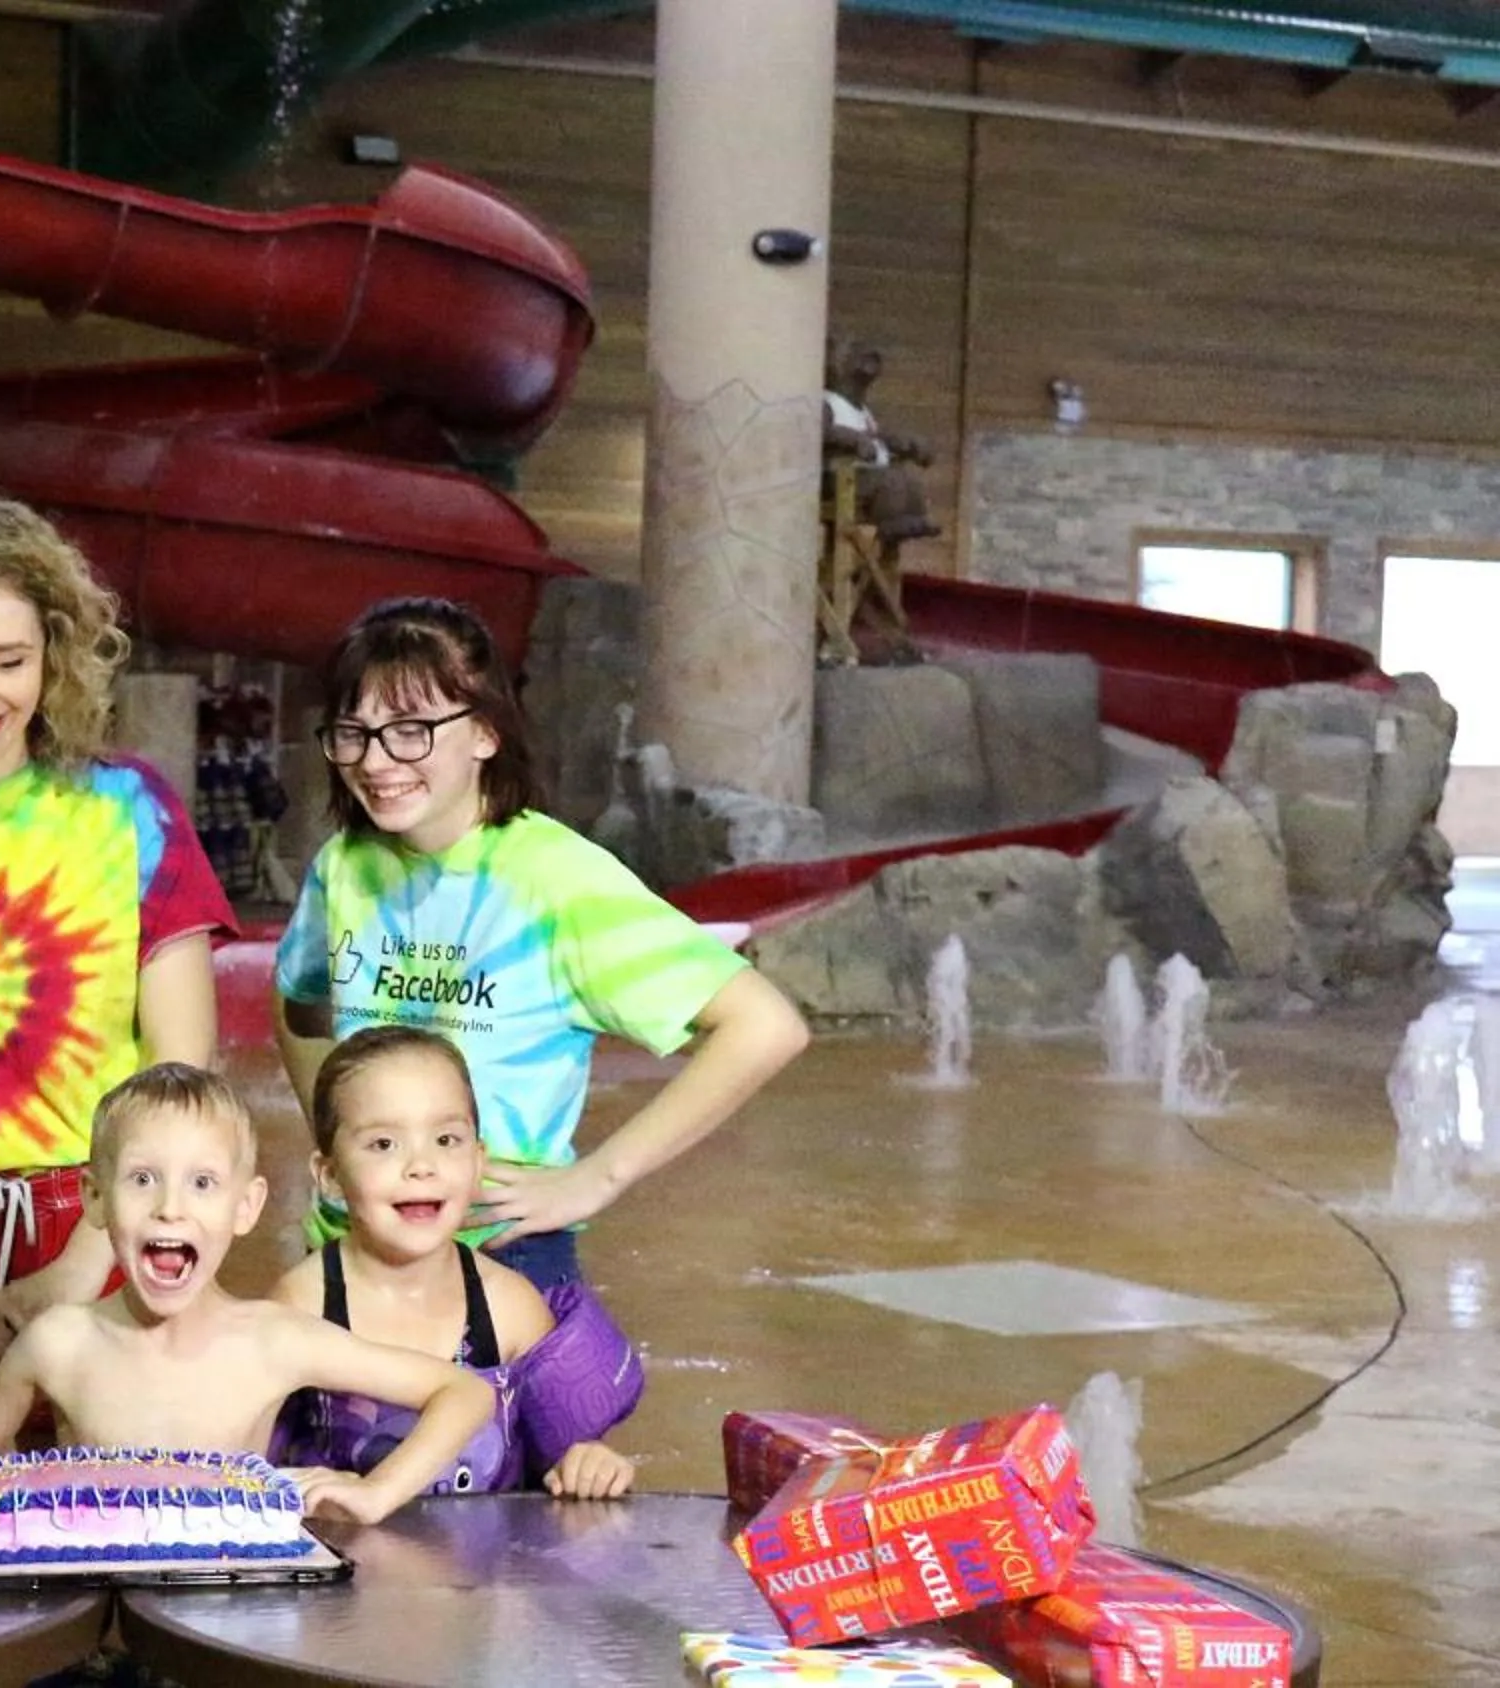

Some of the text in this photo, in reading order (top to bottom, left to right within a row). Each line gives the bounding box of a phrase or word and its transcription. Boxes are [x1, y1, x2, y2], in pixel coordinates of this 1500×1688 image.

[381, 935, 467, 961] Like us on
[373, 965, 497, 1008] Facebook
[876, 1472, 1004, 1531] BIRTHDAY
[765, 1541, 898, 1597] BRTHDAY
